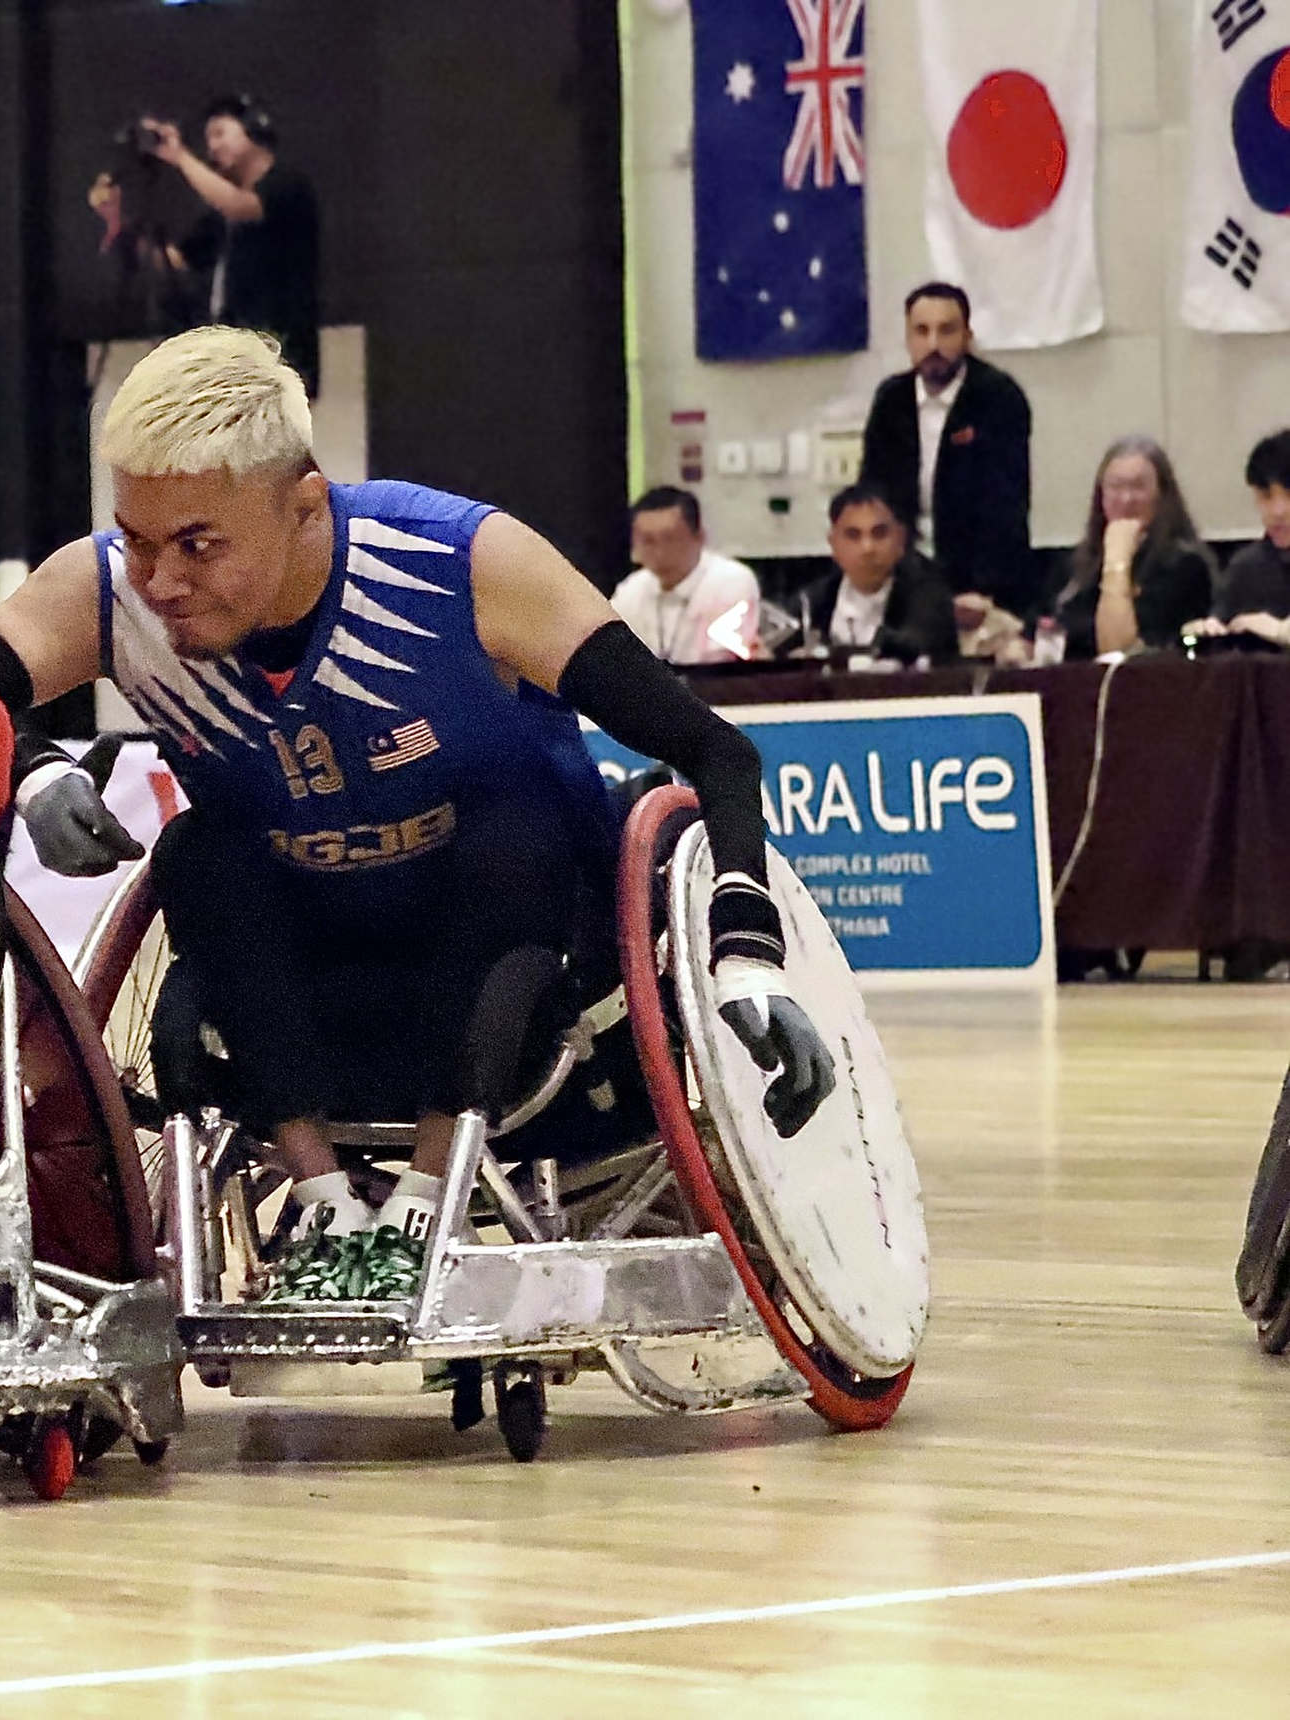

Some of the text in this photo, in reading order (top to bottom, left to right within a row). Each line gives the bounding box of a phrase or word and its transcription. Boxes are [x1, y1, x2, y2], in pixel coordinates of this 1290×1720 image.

[267, 723, 346, 800] 13
[876, 852, 933, 875] HOTEL
[837, 883, 904, 906] CENTRE
